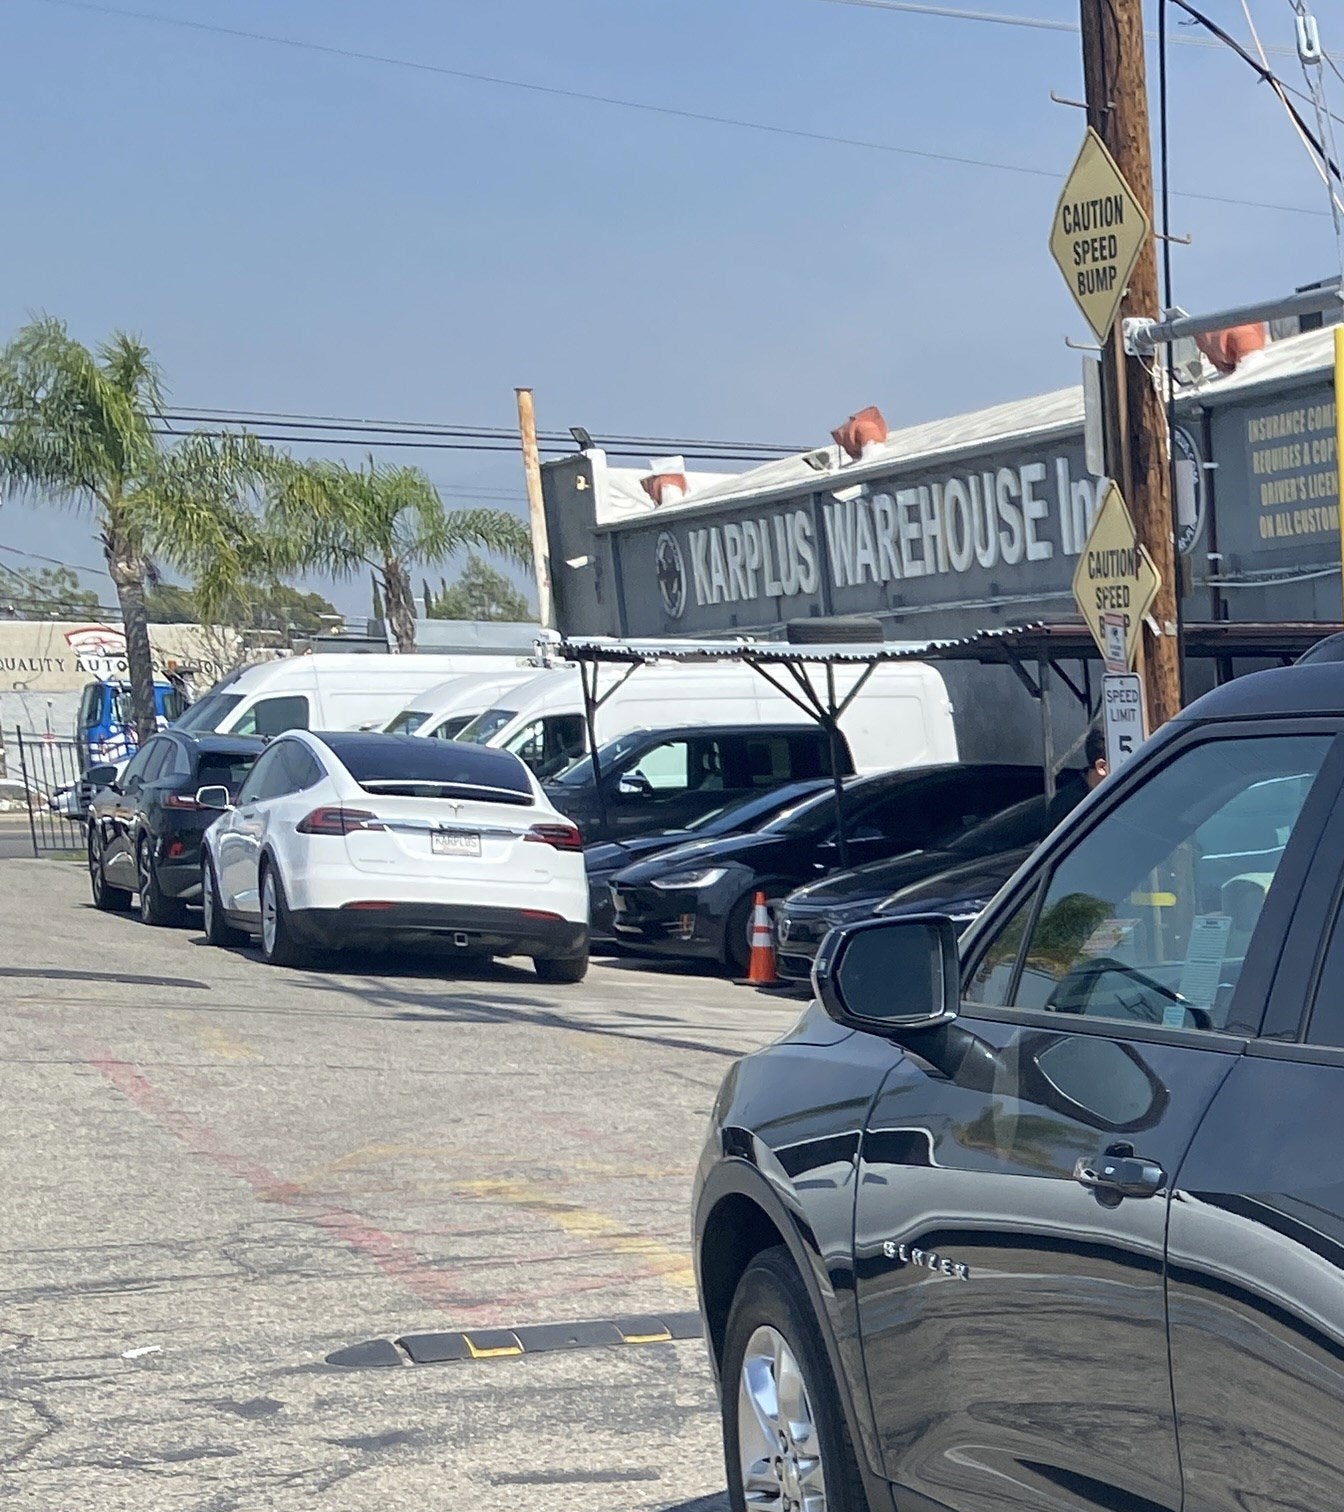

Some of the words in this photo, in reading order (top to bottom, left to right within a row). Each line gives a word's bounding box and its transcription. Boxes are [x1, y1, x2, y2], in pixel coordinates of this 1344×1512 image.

[1063, 194, 1124, 235] CAUTION
[1073, 234, 1118, 266] SPEED
[1077, 265, 1117, 297] BUMP
[1248, 408, 1306, 442] INSURANCE
[1253, 443, 1301, 475] REQUIRES
[1303, 441, 1311, 466] A
[1312, 436, 1339, 464] COP
[1260, 476, 1307, 506] DRIVER'S
[687, 509, 822, 607] KARPLUS
[822, 462, 1055, 588] WAREHOUSE
[1259, 515, 1275, 539] ON
[1275, 511, 1295, 537] ALL
[1087, 548, 1135, 580] CAUTION
[1096, 585, 1130, 610] SPEED
[75, 657, 129, 673] AUTO
[1107, 689, 1139, 703] SPEED
[1110, 708, 1137, 723] LIMIT
[883, 1240, 970, 1282] BLAZER
